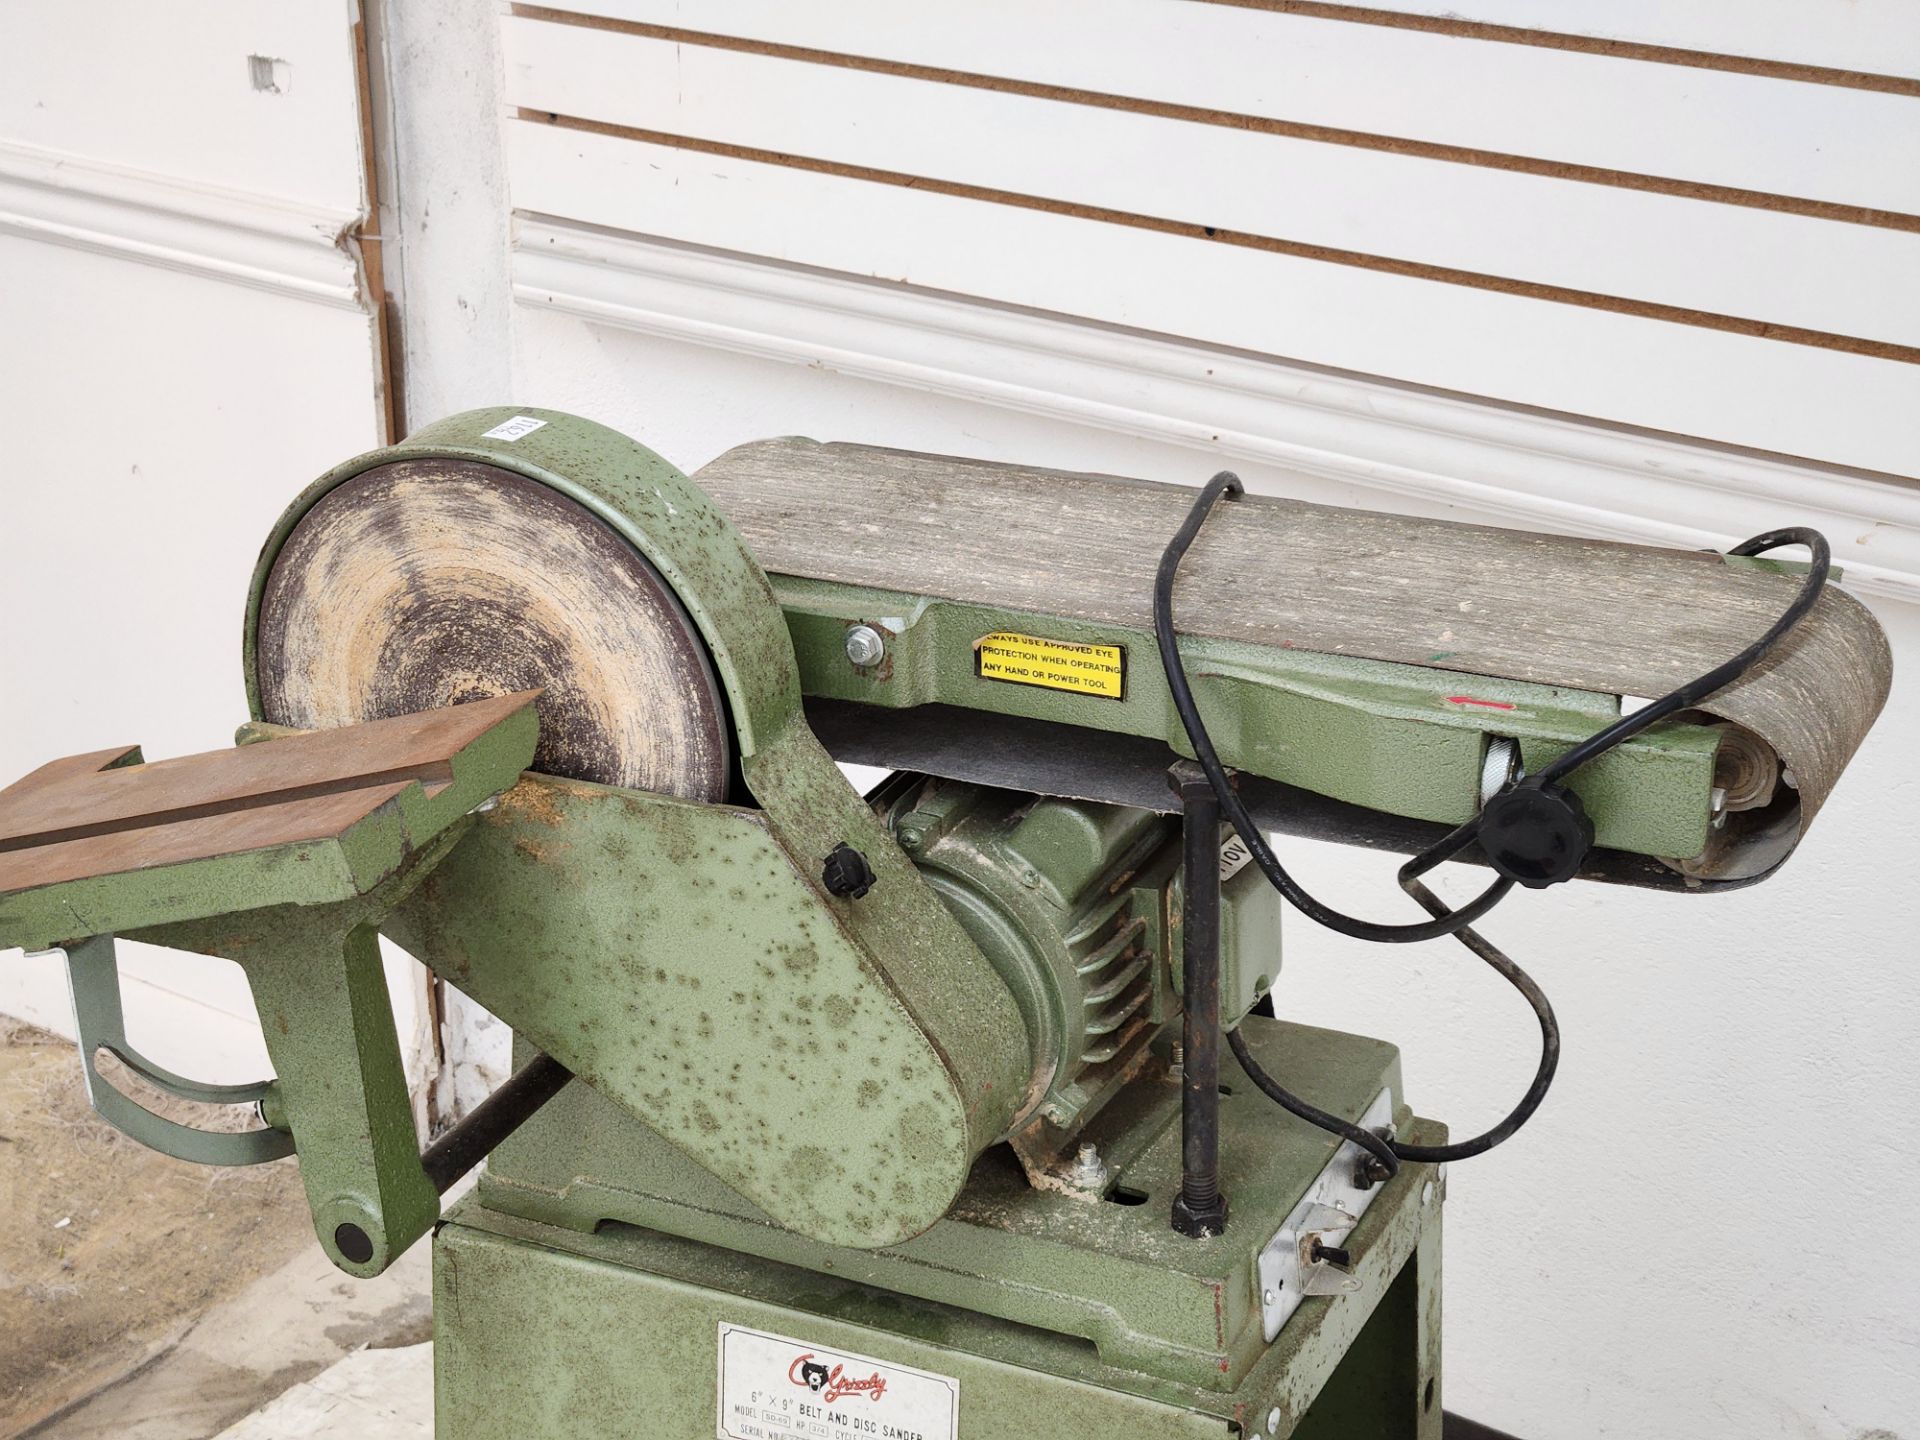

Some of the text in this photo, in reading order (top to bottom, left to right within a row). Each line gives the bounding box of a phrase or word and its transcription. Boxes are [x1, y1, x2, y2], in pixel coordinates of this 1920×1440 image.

[982, 645, 1121, 674] PROTECTION WHEN OPERATING
[987, 635, 1113, 659] WAYS USE APPROVED EYE
[983, 662, 1107, 689] ANY HAND OR POWER TOOL
[1251, 840, 1271, 866] CABLE
[734, 1404, 758, 1419] MODEL
[796, 1420, 806, 1430] HP
[800, 1403, 822, 1419] BELT
[827, 1411, 848, 1426] AND
[854, 1417, 877, 1433] DISC
[882, 1424, 923, 1440] SANDER
[740, 1423, 764, 1439] SERIAL
